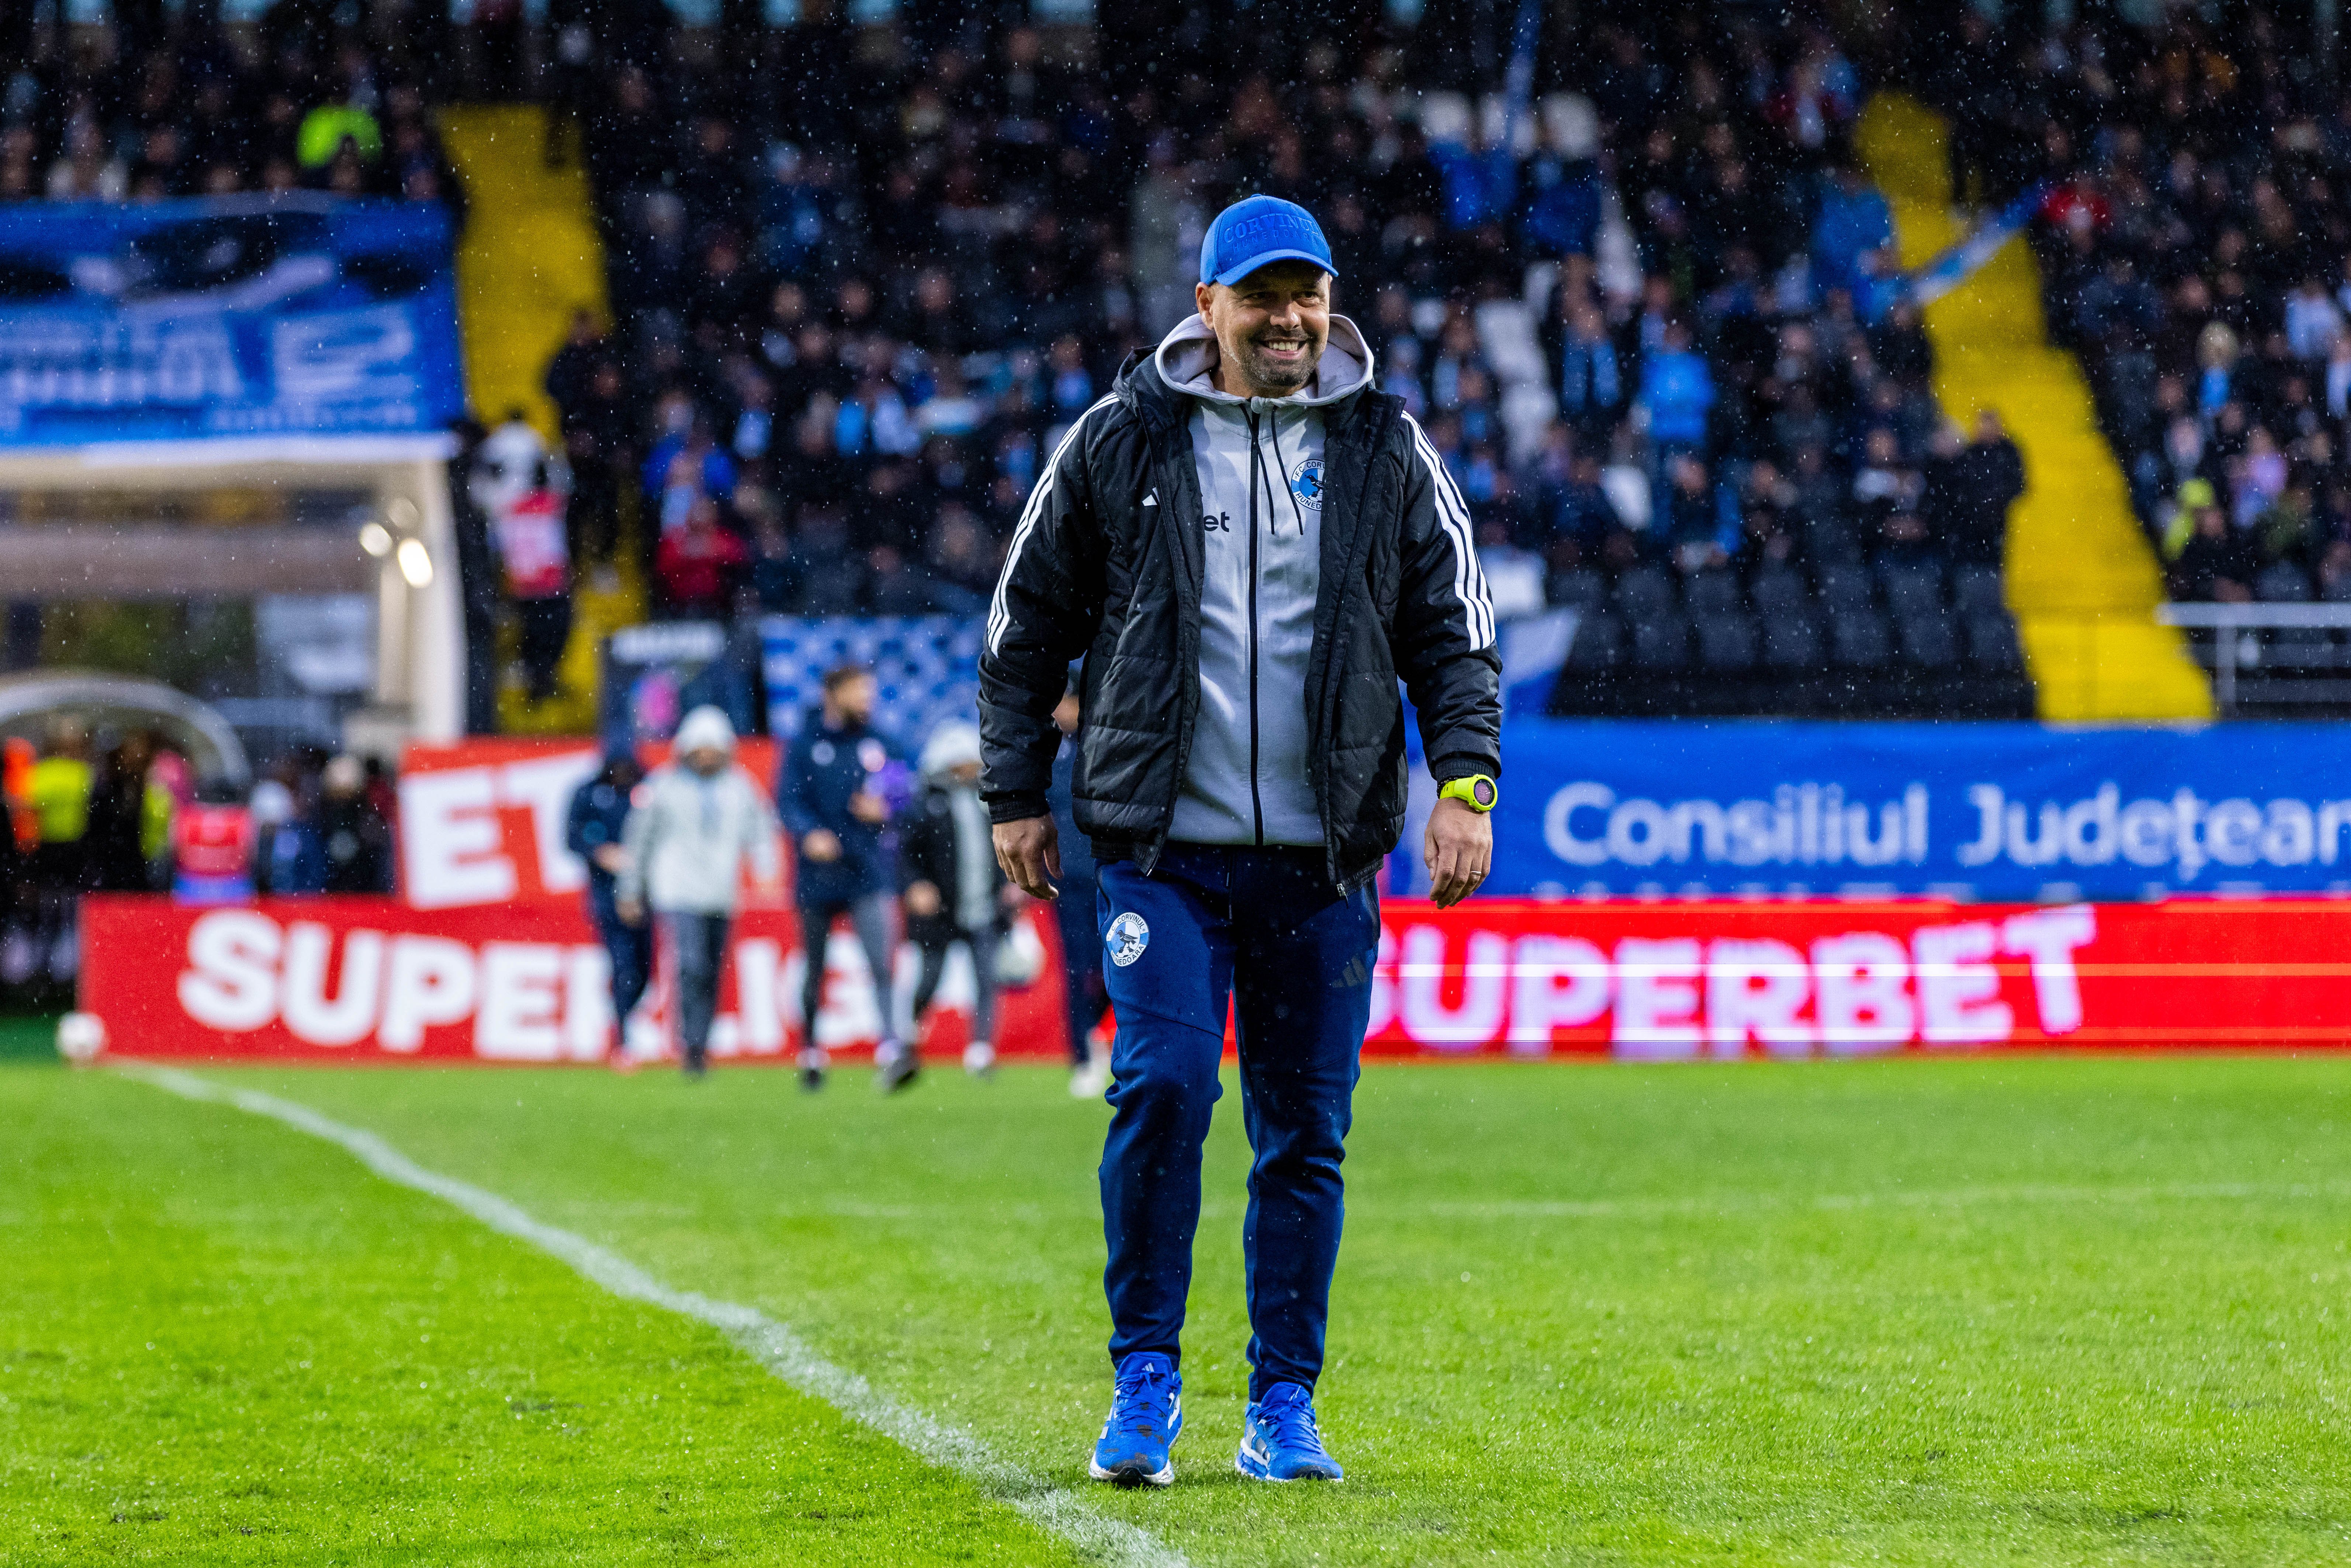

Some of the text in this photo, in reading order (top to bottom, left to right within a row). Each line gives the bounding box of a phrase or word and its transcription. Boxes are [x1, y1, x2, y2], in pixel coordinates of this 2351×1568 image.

[1224, 213, 1319, 243] CORVINUL
[1543, 780, 1928, 867] Consiliul
[1117, 914, 1145, 929] CORVINUL
[1111, 946, 1145, 965] HUNEDOARA
